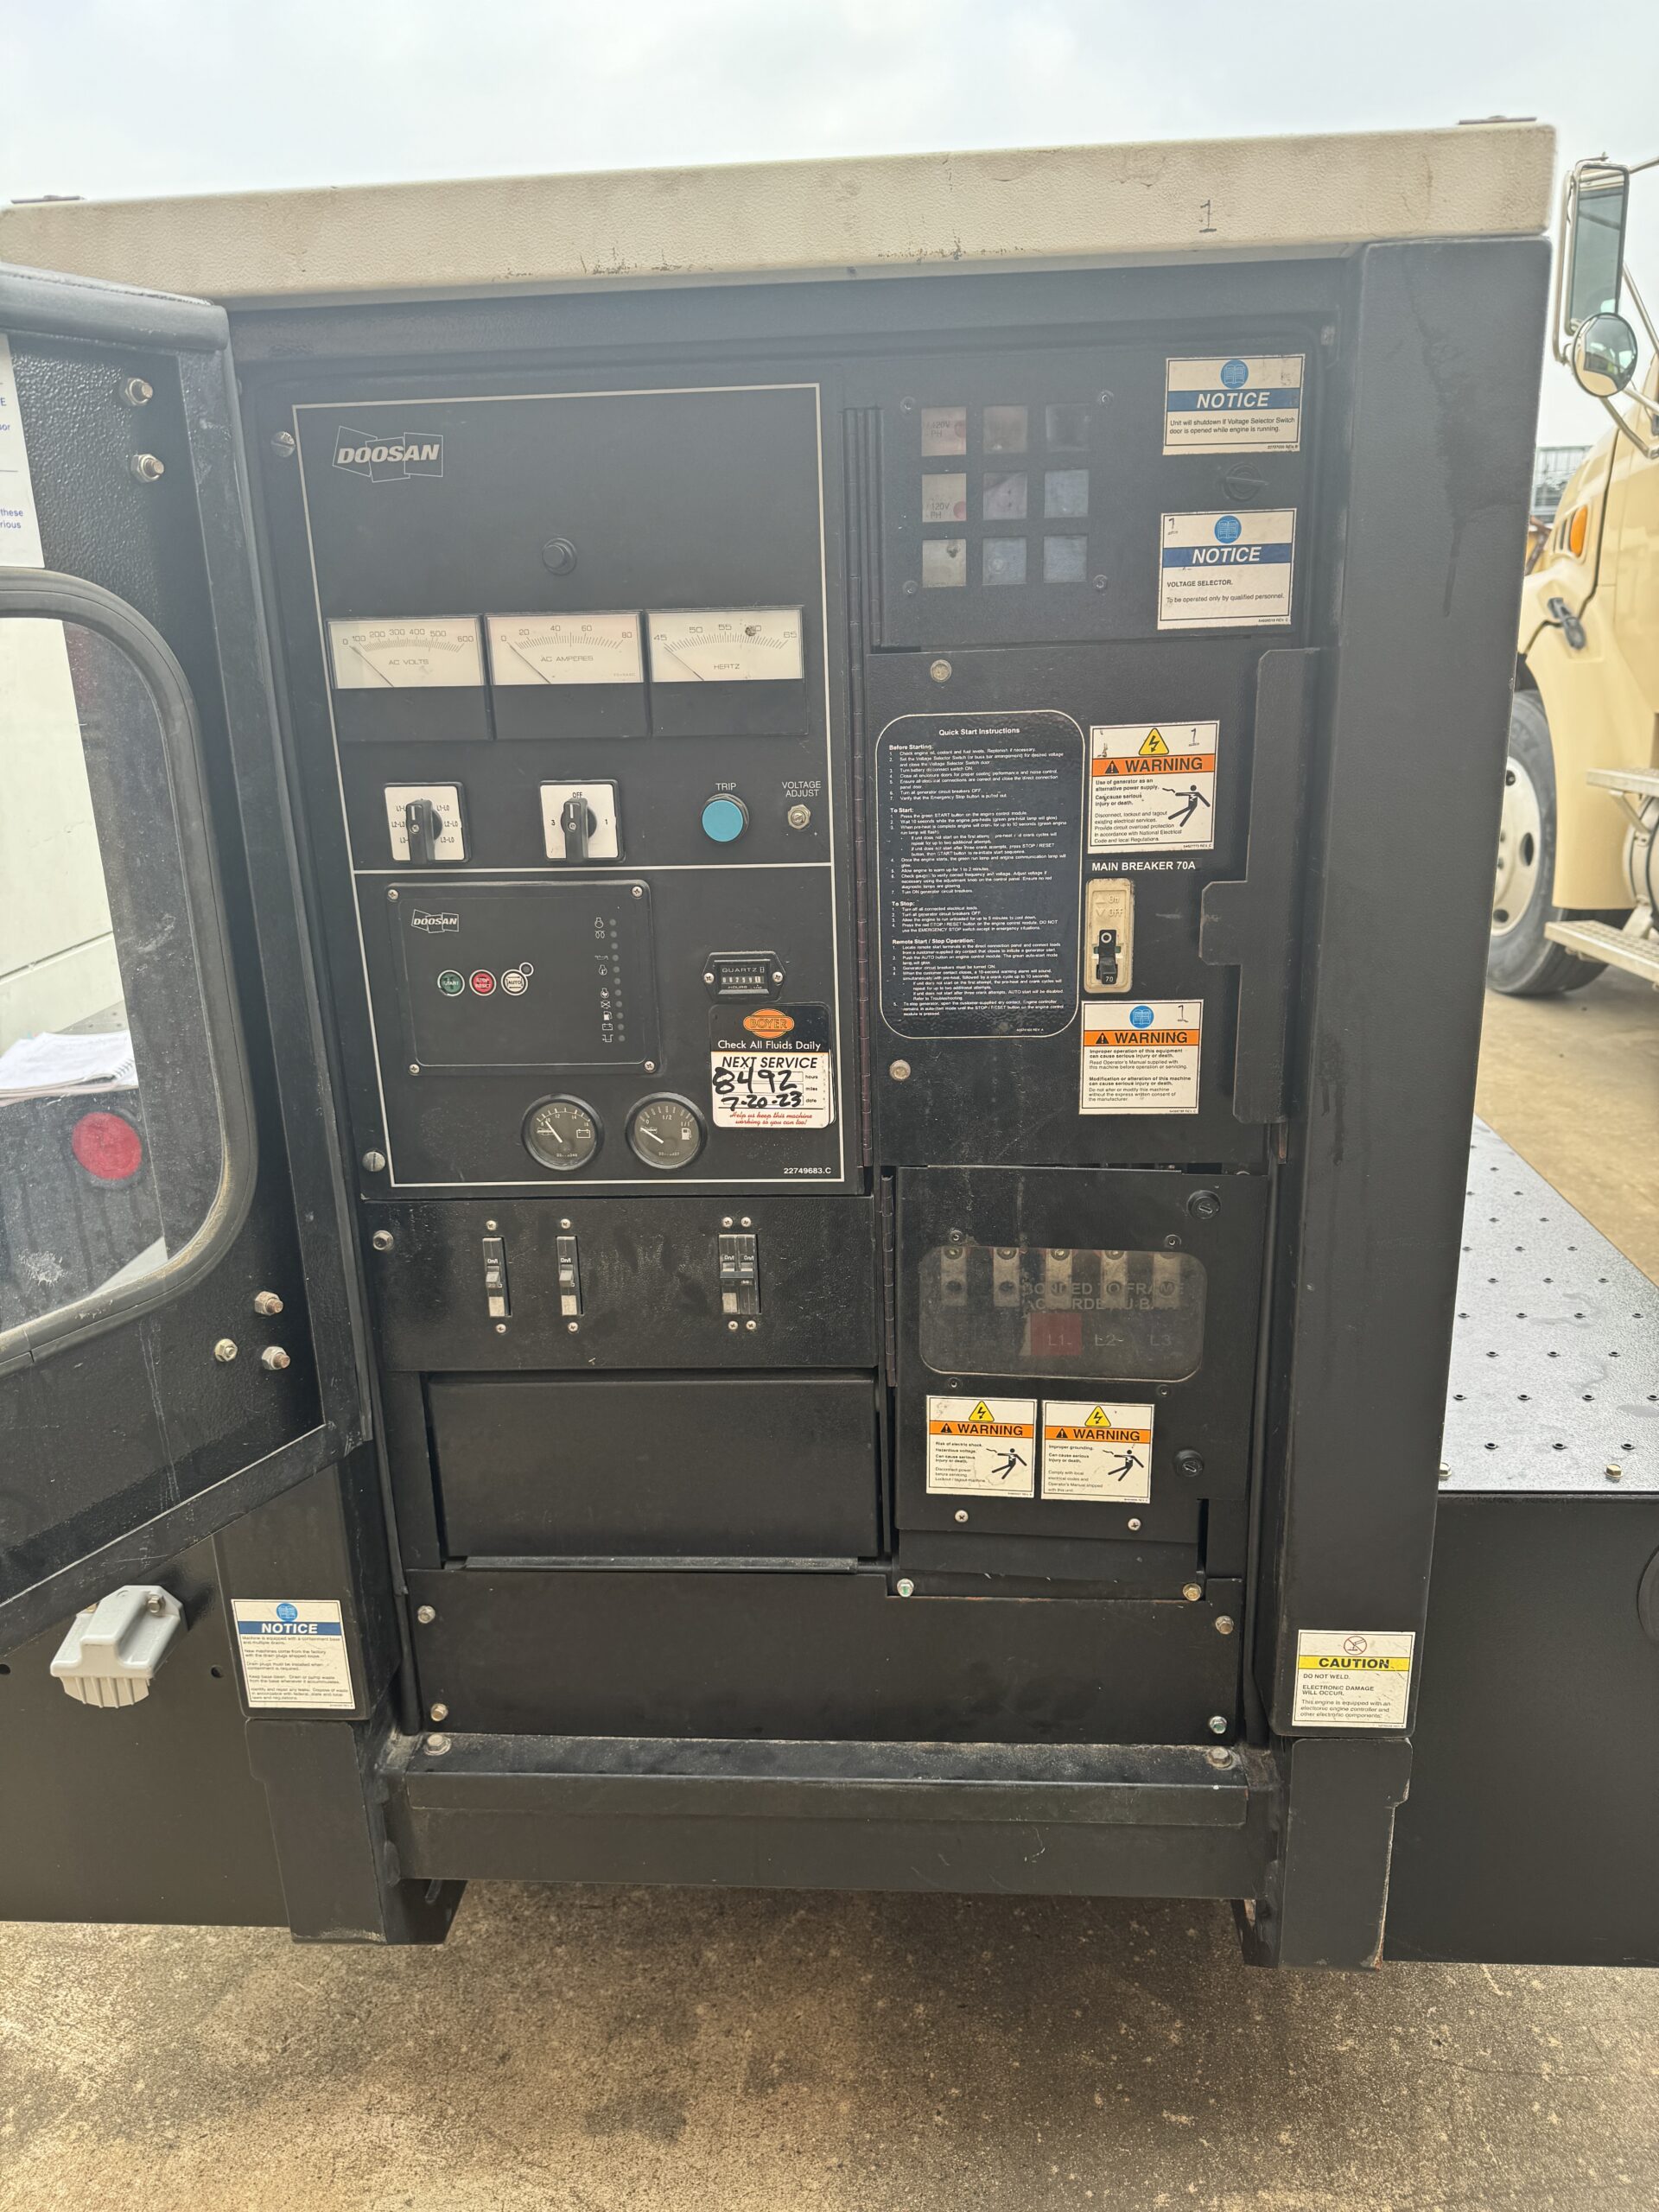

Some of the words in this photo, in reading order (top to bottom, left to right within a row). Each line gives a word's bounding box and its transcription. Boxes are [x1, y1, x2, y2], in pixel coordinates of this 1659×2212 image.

[1197, 391, 1270, 408] NOTICE
[337, 444, 440, 464] DOOSAN
[1192, 546, 1262, 564] NOTICE
[1125, 757, 1203, 772] WARNING
[715, 782, 737, 791] TRIP
[782, 780, 821, 789] VOLTAGE
[785, 789, 819, 798] ADJUST
[1092, 862, 1118, 871] MAIN
[1122, 861, 1173, 871] BREAKER
[1176, 861, 1196, 870] 70A
[750, 1019, 787, 1028] BOYER
[1115, 1032, 1188, 1044] WARNING
[717, 1040, 747, 1050] Check
[750, 1040, 762, 1049] All
[766, 1040, 792, 1050] Fluids
[796, 1040, 821, 1051] Daily
[722, 1056, 757, 1068] NEXT
[760, 1058, 817, 1068] SERVICE
[713, 1066, 797, 1094] 8492
[957, 1423, 1023, 1436] WARNING
[1073, 1428, 1141, 1441] WARNING
[261, 1624, 318, 1633] NOTICE
[1319, 1658, 1389, 1669] CAUTION
